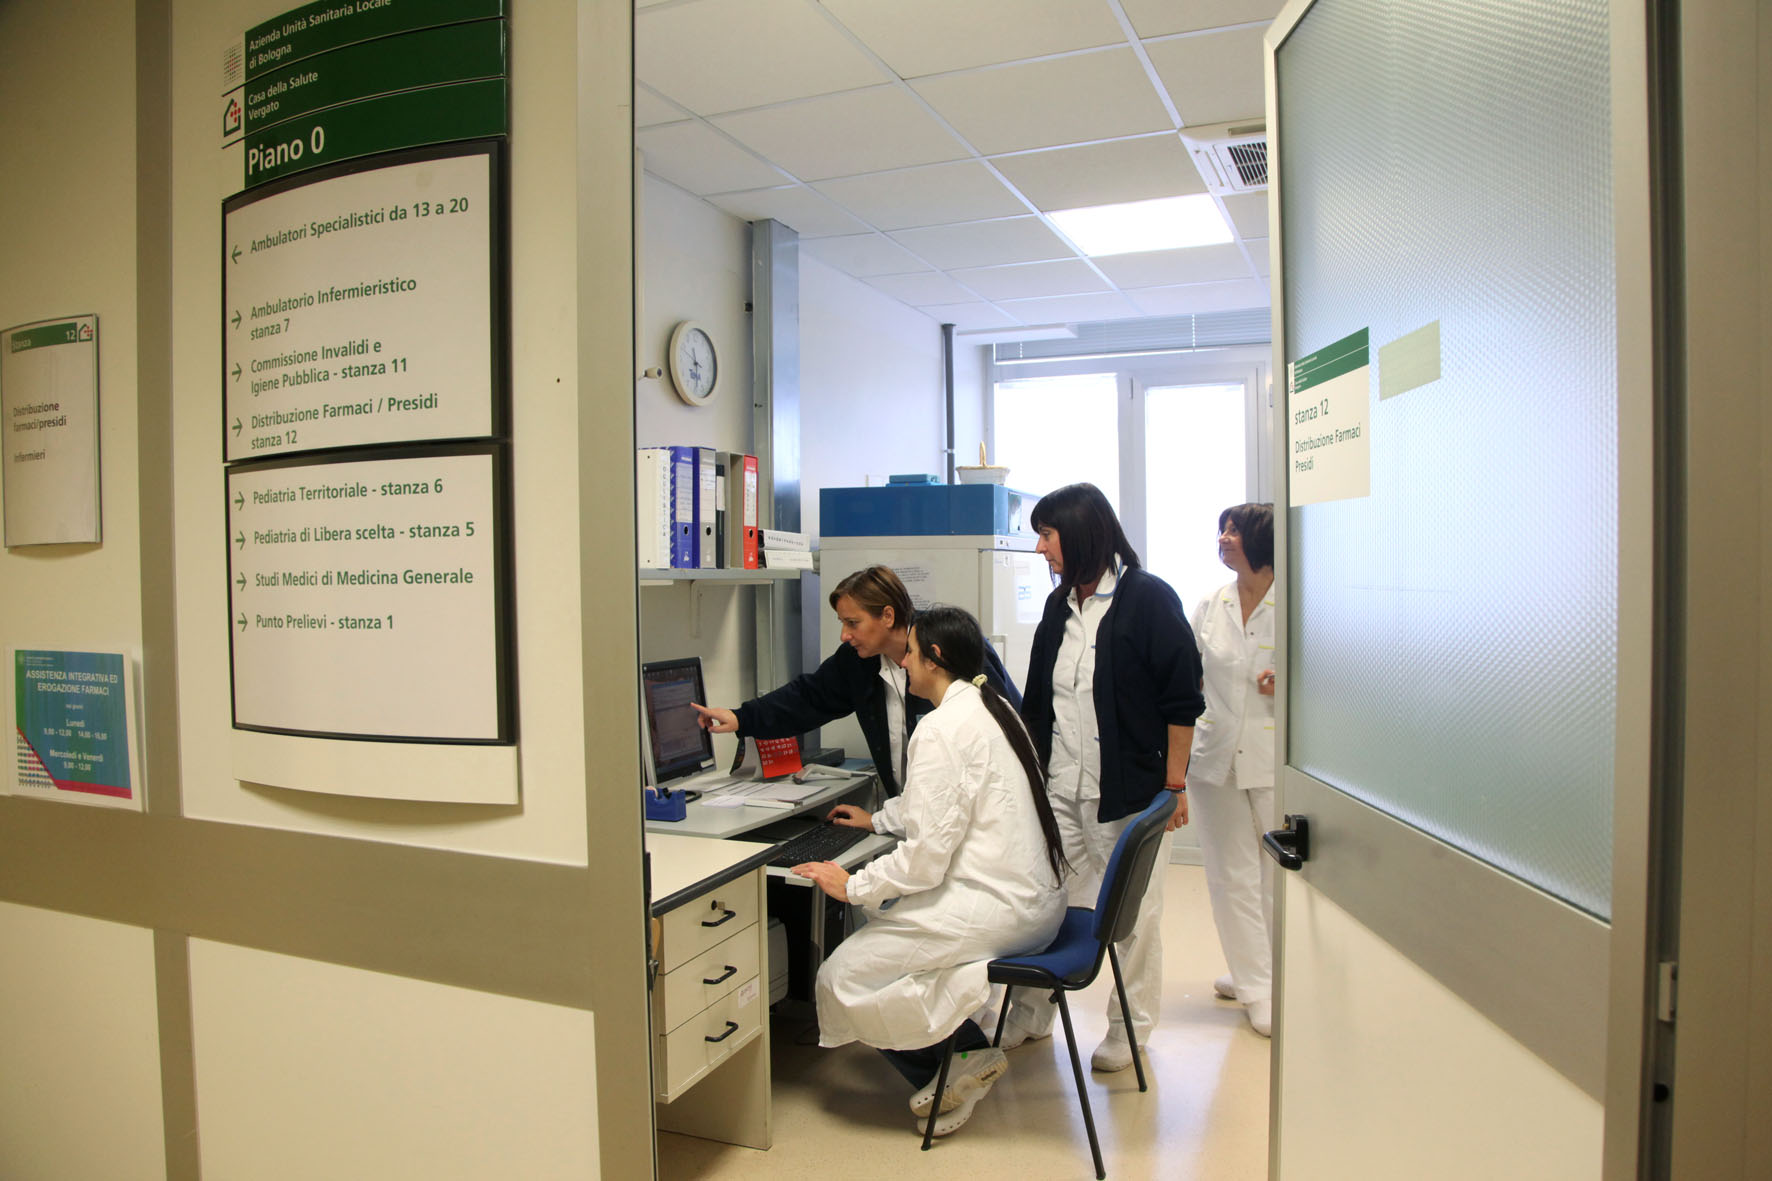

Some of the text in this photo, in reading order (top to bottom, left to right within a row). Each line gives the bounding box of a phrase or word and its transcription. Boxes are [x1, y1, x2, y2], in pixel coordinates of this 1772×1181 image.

[250, 30, 280, 52] Azienda
[282, 18, 307, 36] Unità
[309, 4, 353, 27] Sanitaria
[249, 44, 292, 70] di Bologna
[248, 72, 318, 105] Casa della Salute
[248, 101, 280, 120] Vergato
[248, 126, 324, 176] Piano 0
[250, 197, 469, 254] Ambulatori Specialistici da 13 a 20
[250, 277, 416, 320] Ambulatorio Infermieristico
[66, 330, 75, 341] 12
[250, 318, 290, 340] stanza 7
[250, 339, 382, 374] Commissione Invalidi e
[251, 378, 279, 397] Igiene
[282, 367, 330, 388] Pubblica
[341, 361, 386, 379] stanza
[392, 358, 407, 372] 11
[13, 402, 59, 417] Distribuzione
[251, 393, 438, 429] Distribuzione Farmaci / Presidi
[1295, 398, 1329, 425] stanza 12
[251, 430, 297, 450] stanza 12
[1295, 422, 1361, 453] Distribuzione Farmaci
[1295, 456, 1314, 472] Presidi
[253, 487, 296, 504] Pediatria
[299, 482, 368, 501] Territoriale
[381, 480, 429, 496] stanza
[434, 478, 443, 494] 6
[254, 528, 297, 544] Pediatria
[300, 526, 310, 542] di
[314, 525, 352, 542] Libera
[356, 524, 395, 540] scelta
[409, 523, 460, 538] stanza
[465, 522, 475, 536] 5
[256, 568, 474, 586] Studi Medici di Medicina Generale
[256, 614, 284, 628] Punto
[286, 614, 327, 629] Prelievi
[338, 616, 382, 629] stanza
[387, 615, 393, 629] 1
[26, 670, 118, 683] ASSISTENZA INTEGRATIVA ED
[37, 683, 109, 696] EROGAZIONE FARMACI
